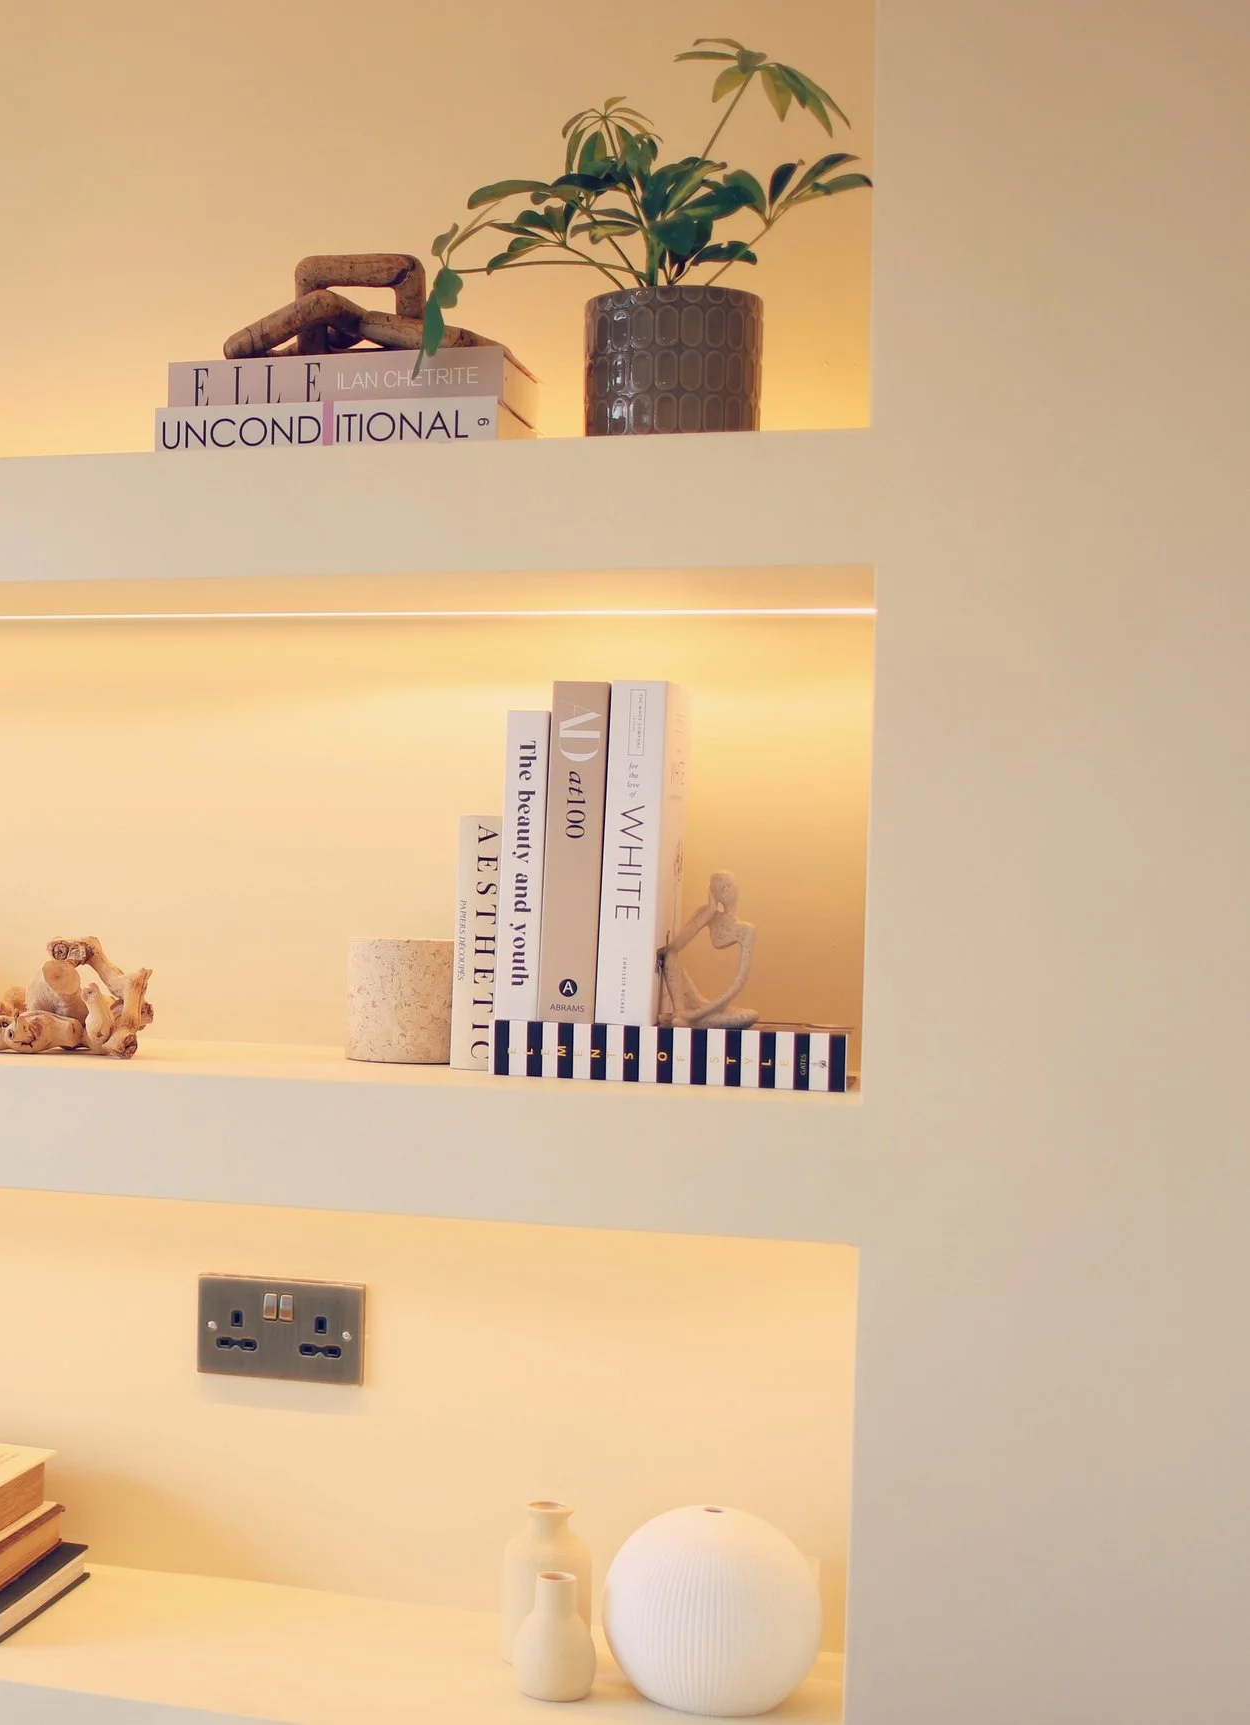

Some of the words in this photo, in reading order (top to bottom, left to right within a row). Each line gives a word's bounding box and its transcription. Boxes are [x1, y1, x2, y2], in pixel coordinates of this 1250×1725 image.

[192, 362, 322, 407] ELLE
[336, 370, 378, 391] ILAN
[383, 365, 479, 389] CHETRITE
[161, 409, 469, 450] UNCONDITIONAL
[558, 698, 603, 763] AD
[518, 739, 537, 781] The
[629, 762, 639, 771] for
[629, 771, 639, 779] the
[626, 781, 640, 789] love
[629, 790, 637, 798] of
[512, 790, 536, 864] beauty
[615, 804, 646, 920] WHITE
[513, 872, 532, 913] and
[459, 899, 467, 935] PAPIERS
[456, 936, 467, 981] DÉCOUPÉS
[470, 823, 499, 1059] AESTHETIC
[509, 923, 530, 987] youth
[550, 1003, 585, 1013] ABRAMS
[799, 1053, 807, 1077] GATES
